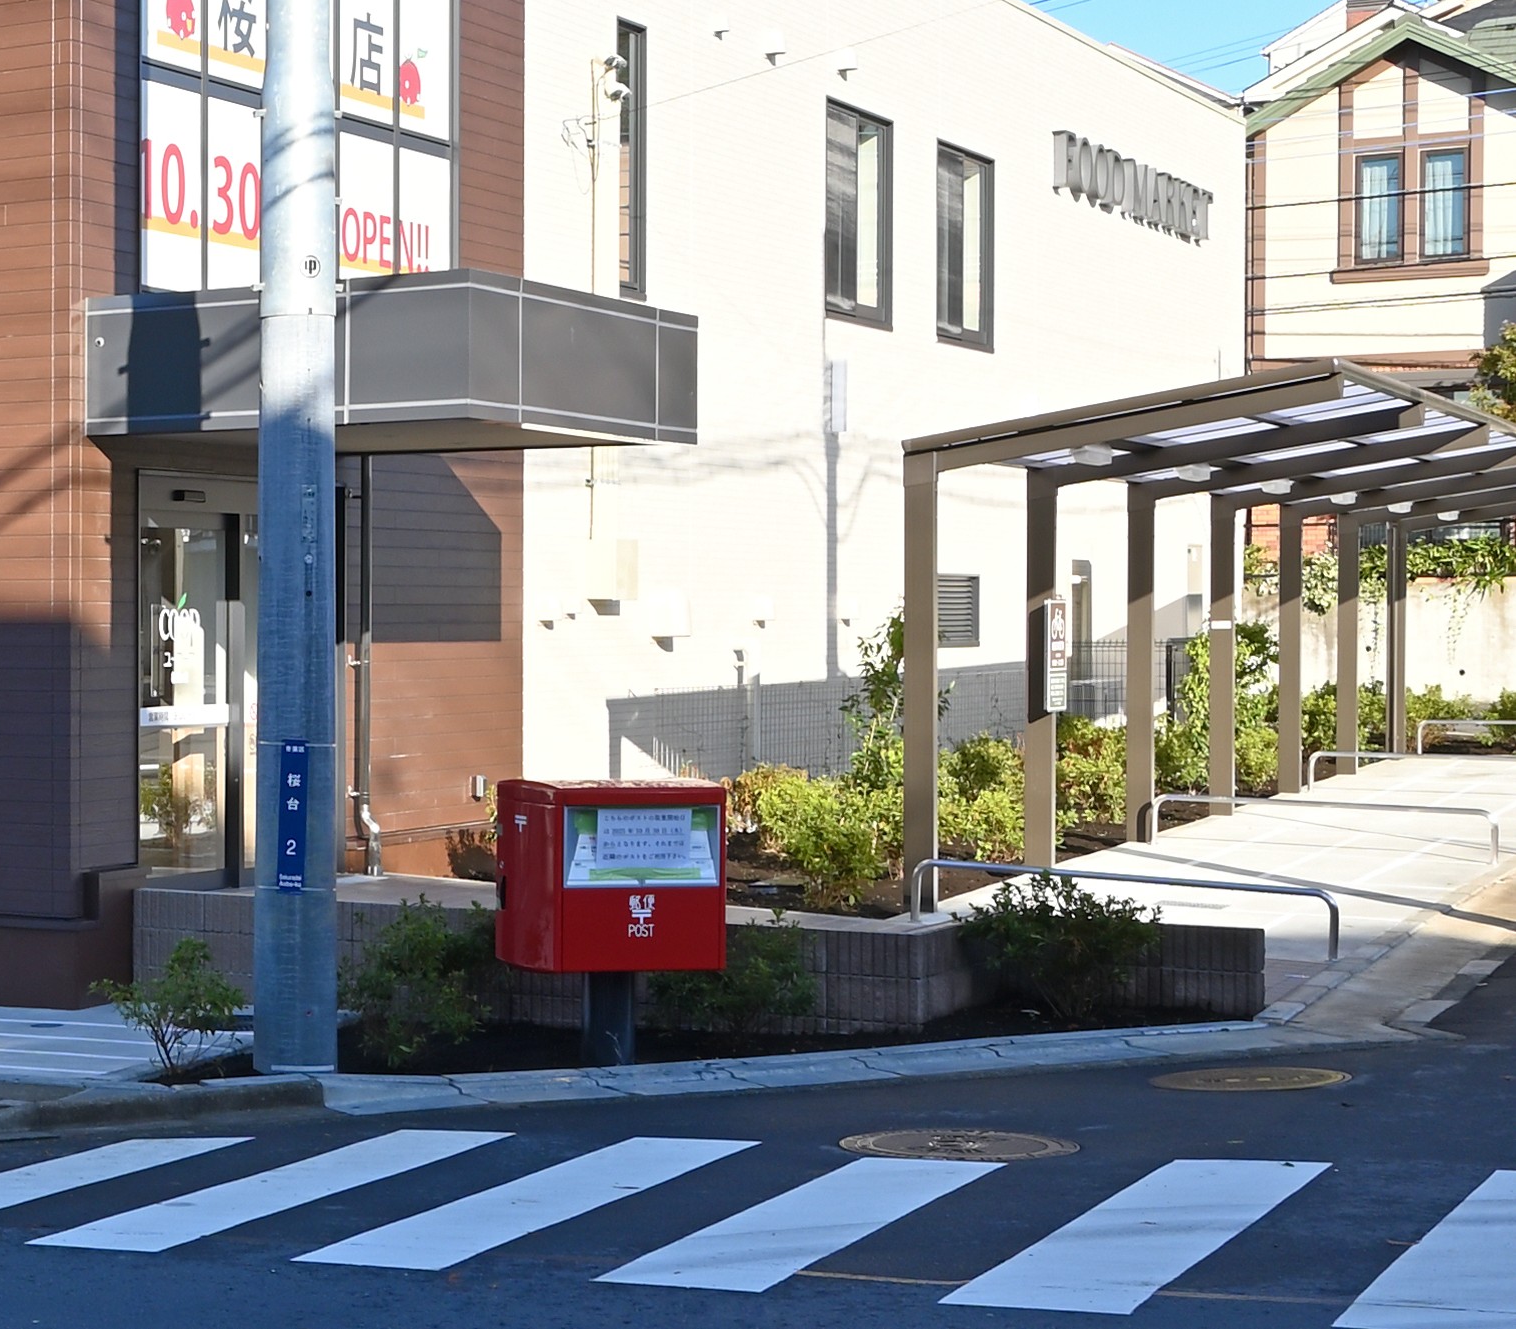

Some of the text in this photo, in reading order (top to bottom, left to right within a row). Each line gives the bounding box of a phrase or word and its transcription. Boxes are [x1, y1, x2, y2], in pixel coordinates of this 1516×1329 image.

[1052, 130, 1214, 248] FOOD MARKET
[285, 773, 302, 856] 桜台 2
[629, 894, 656, 910] 郵便
[628, 923, 655, 937] POST
